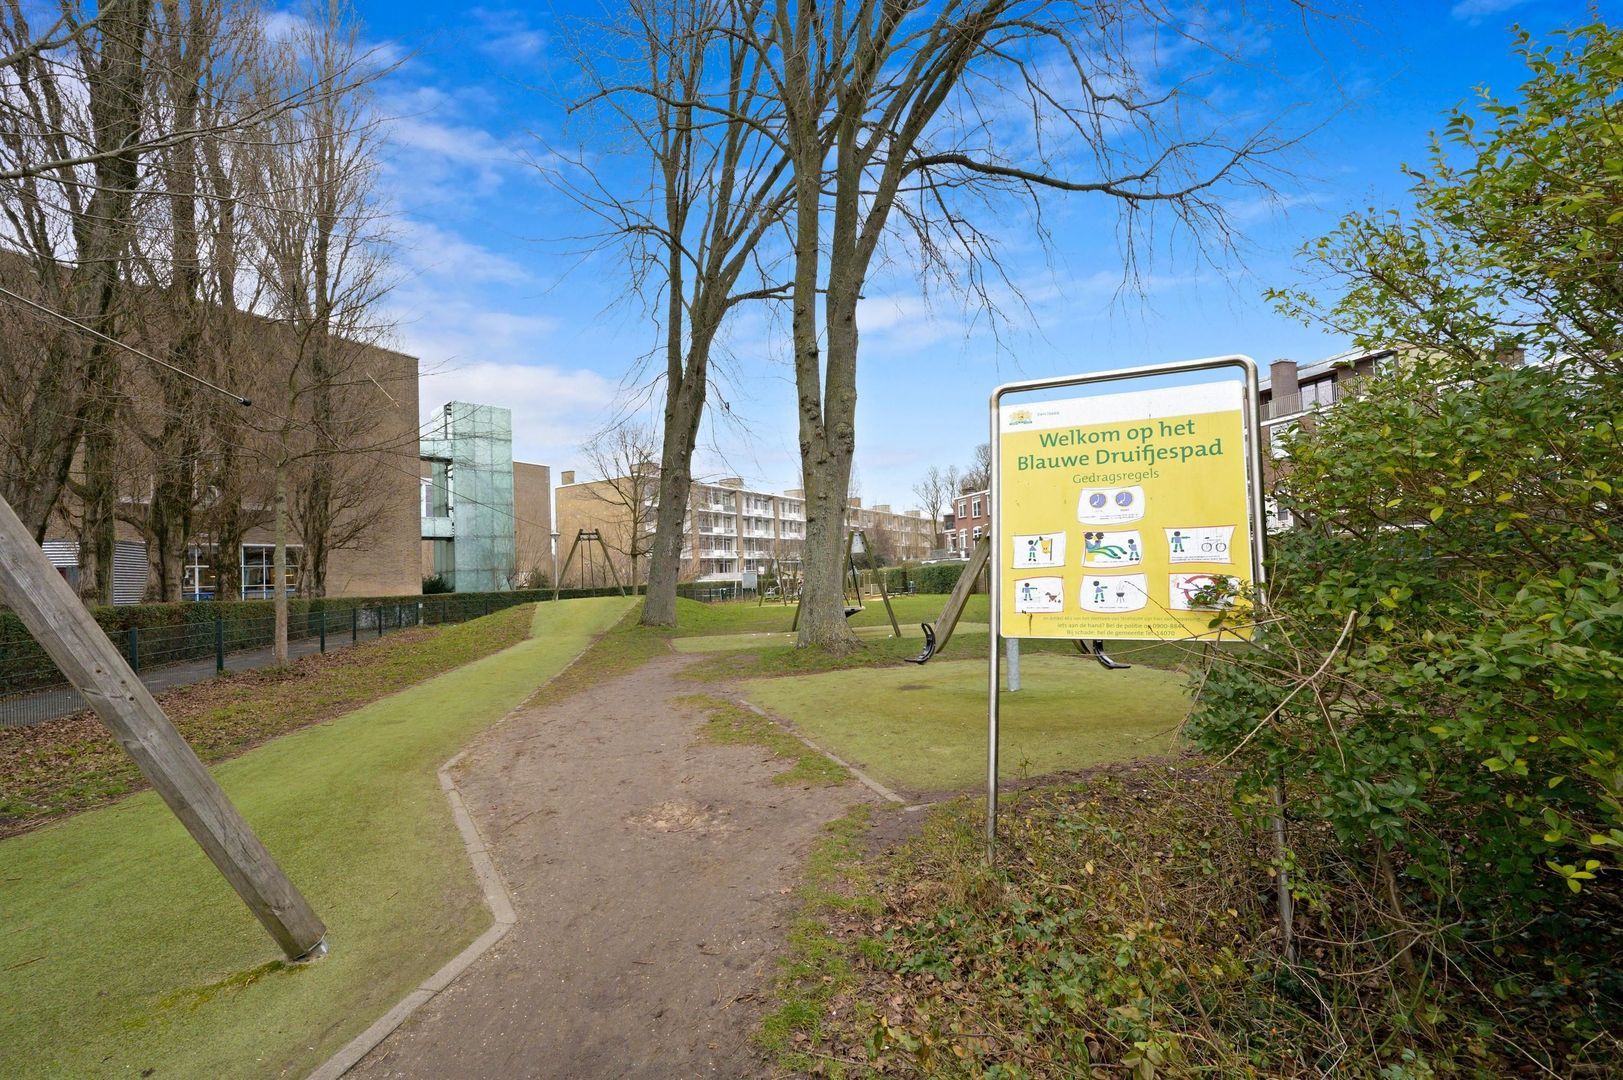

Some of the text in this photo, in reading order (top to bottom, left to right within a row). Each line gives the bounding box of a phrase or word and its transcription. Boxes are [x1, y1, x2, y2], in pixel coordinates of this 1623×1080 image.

[1039, 419, 1196, 448] Welkom op het
[1017, 438, 1223, 471] Blauwe Druifjespad
[1072, 468, 1160, 484] Gedragsregels
